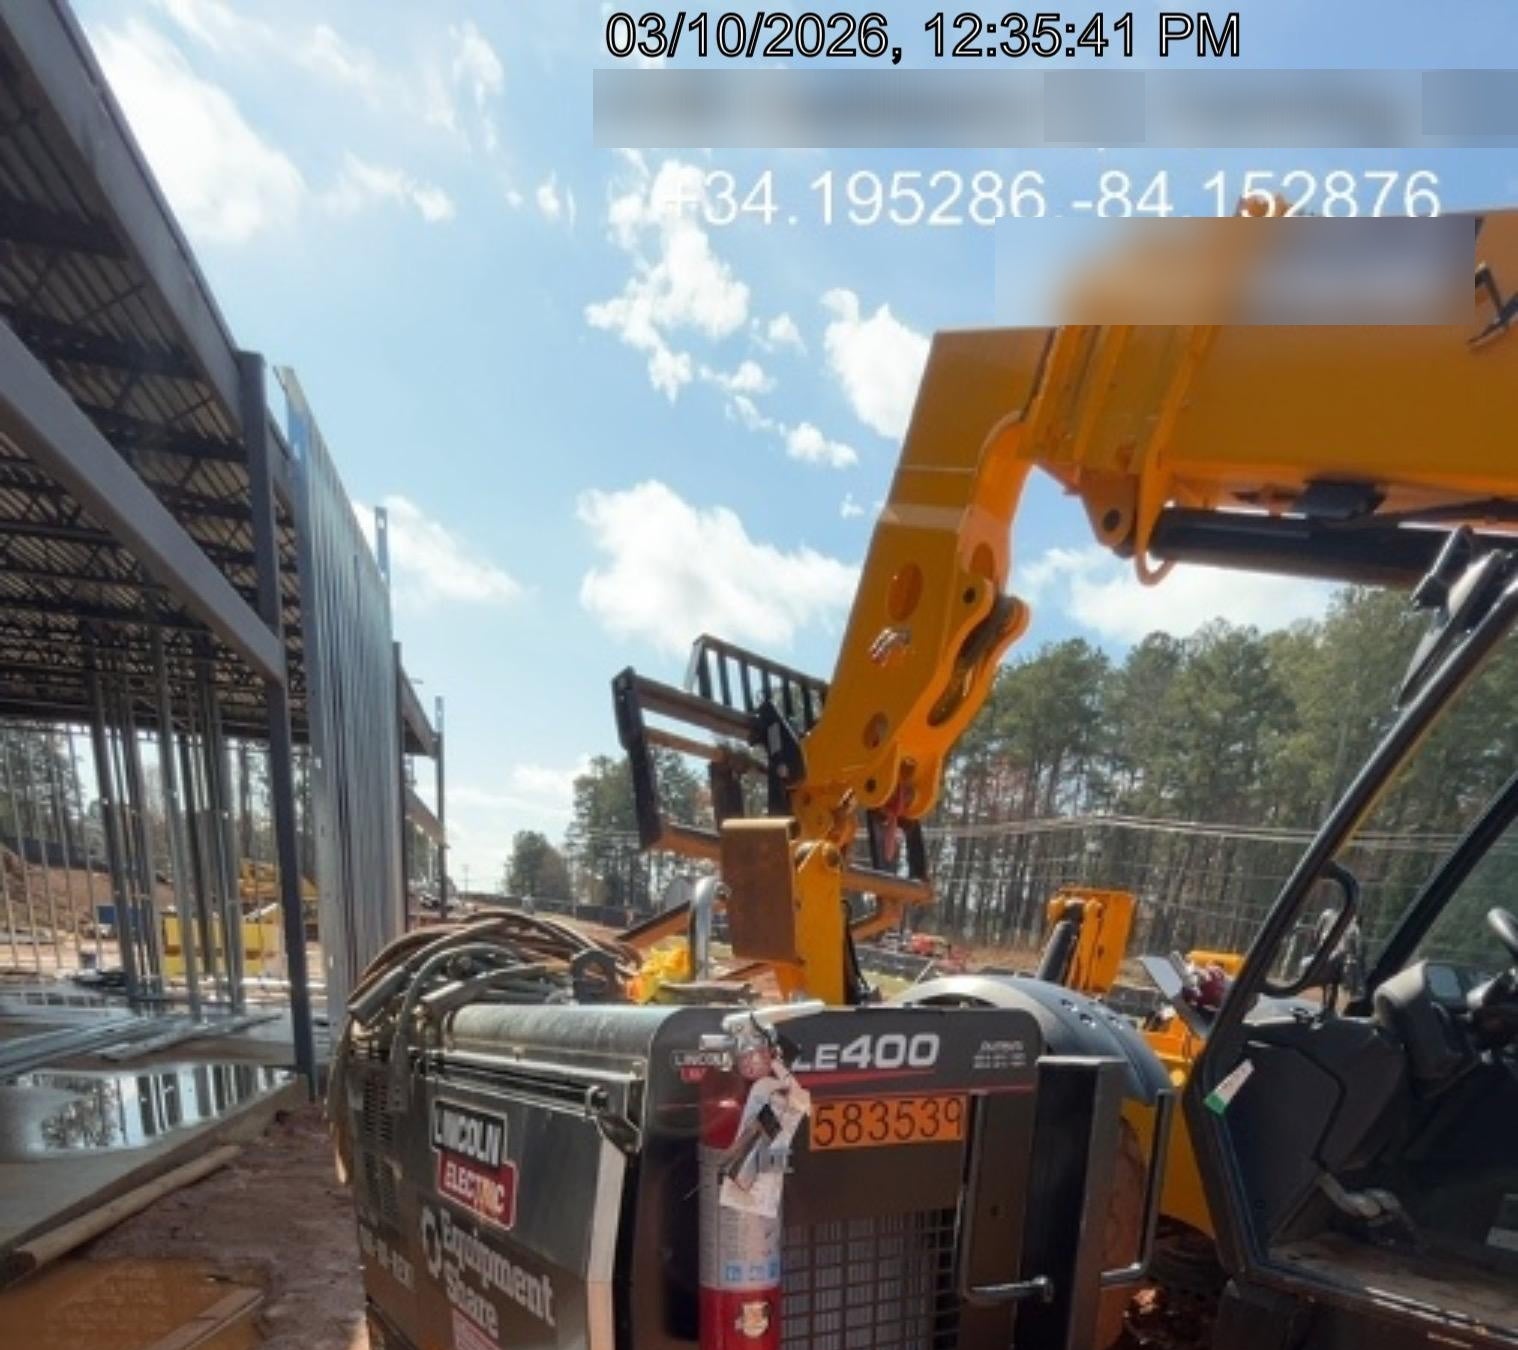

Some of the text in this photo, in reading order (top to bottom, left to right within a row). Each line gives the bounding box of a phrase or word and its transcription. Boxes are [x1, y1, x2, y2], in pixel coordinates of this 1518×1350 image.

[434, 1107, 502, 1168] LINCOLN
[813, 1097, 962, 1147] 583539
[444, 1160, 506, 1215] ELECTRIC
[440, 1207, 556, 1327] Equipment
[443, 1260, 499, 1341] Share
